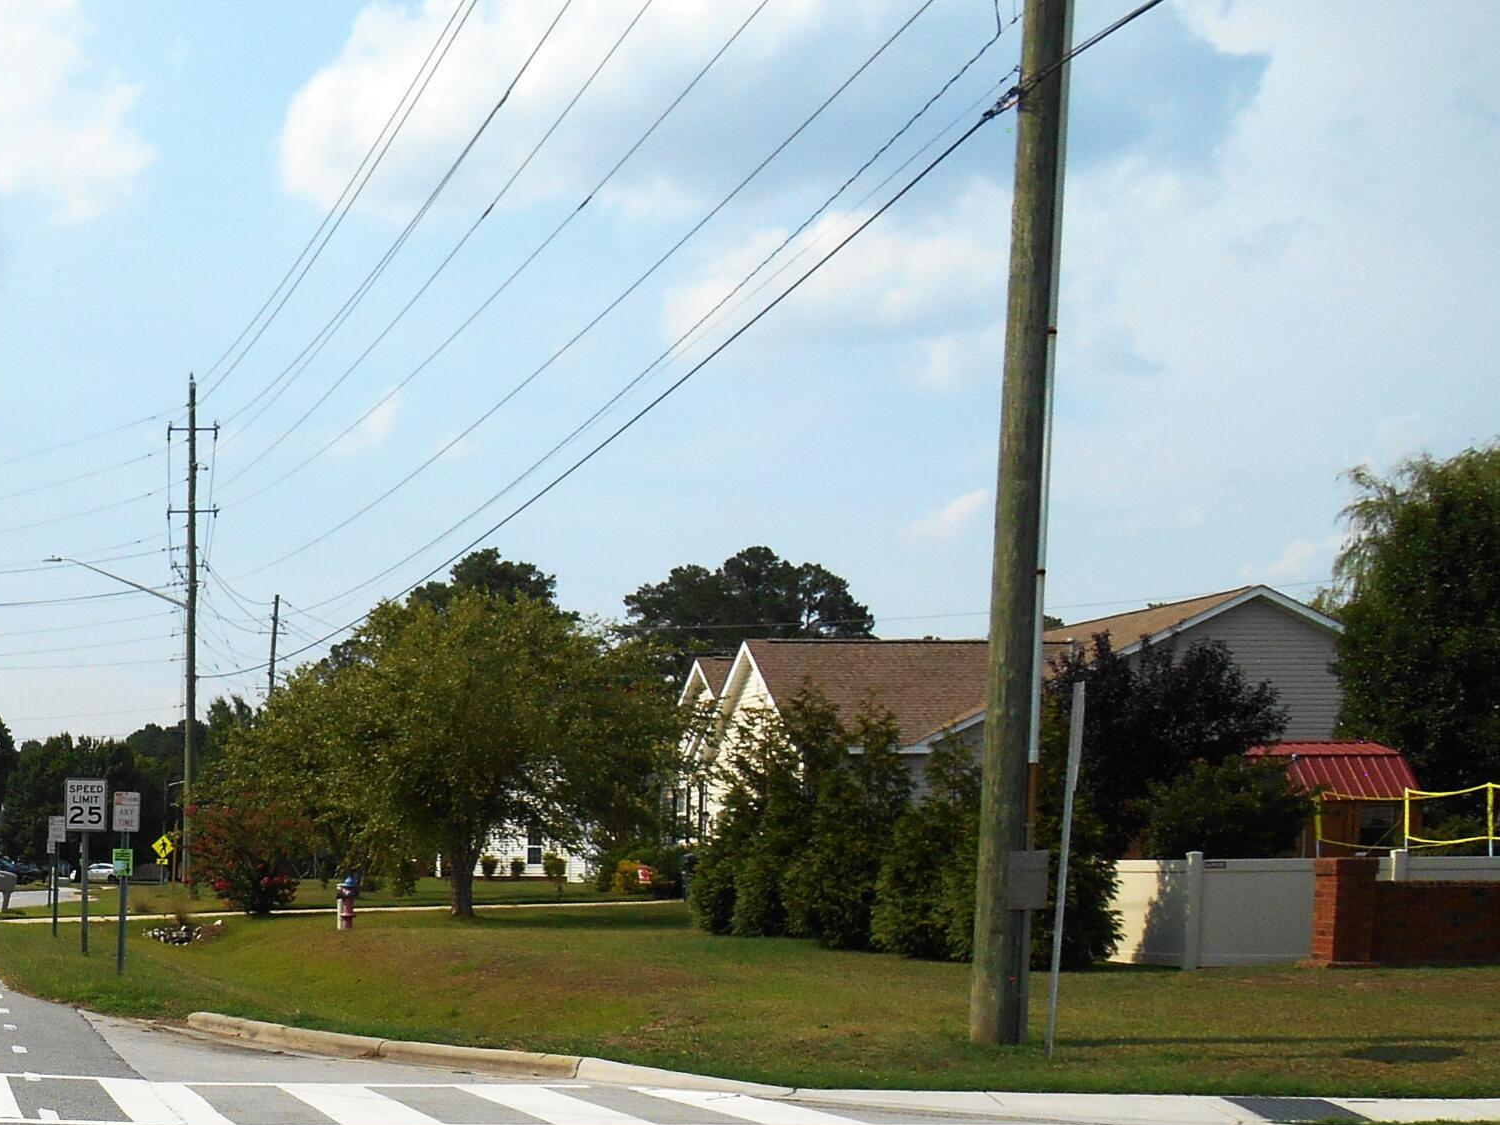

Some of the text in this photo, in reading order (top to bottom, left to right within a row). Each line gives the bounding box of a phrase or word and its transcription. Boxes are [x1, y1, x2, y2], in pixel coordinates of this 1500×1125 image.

[69, 784, 103, 793] SPEED
[72, 795, 99, 804] LIMIT
[69, 805, 102, 824] 25
